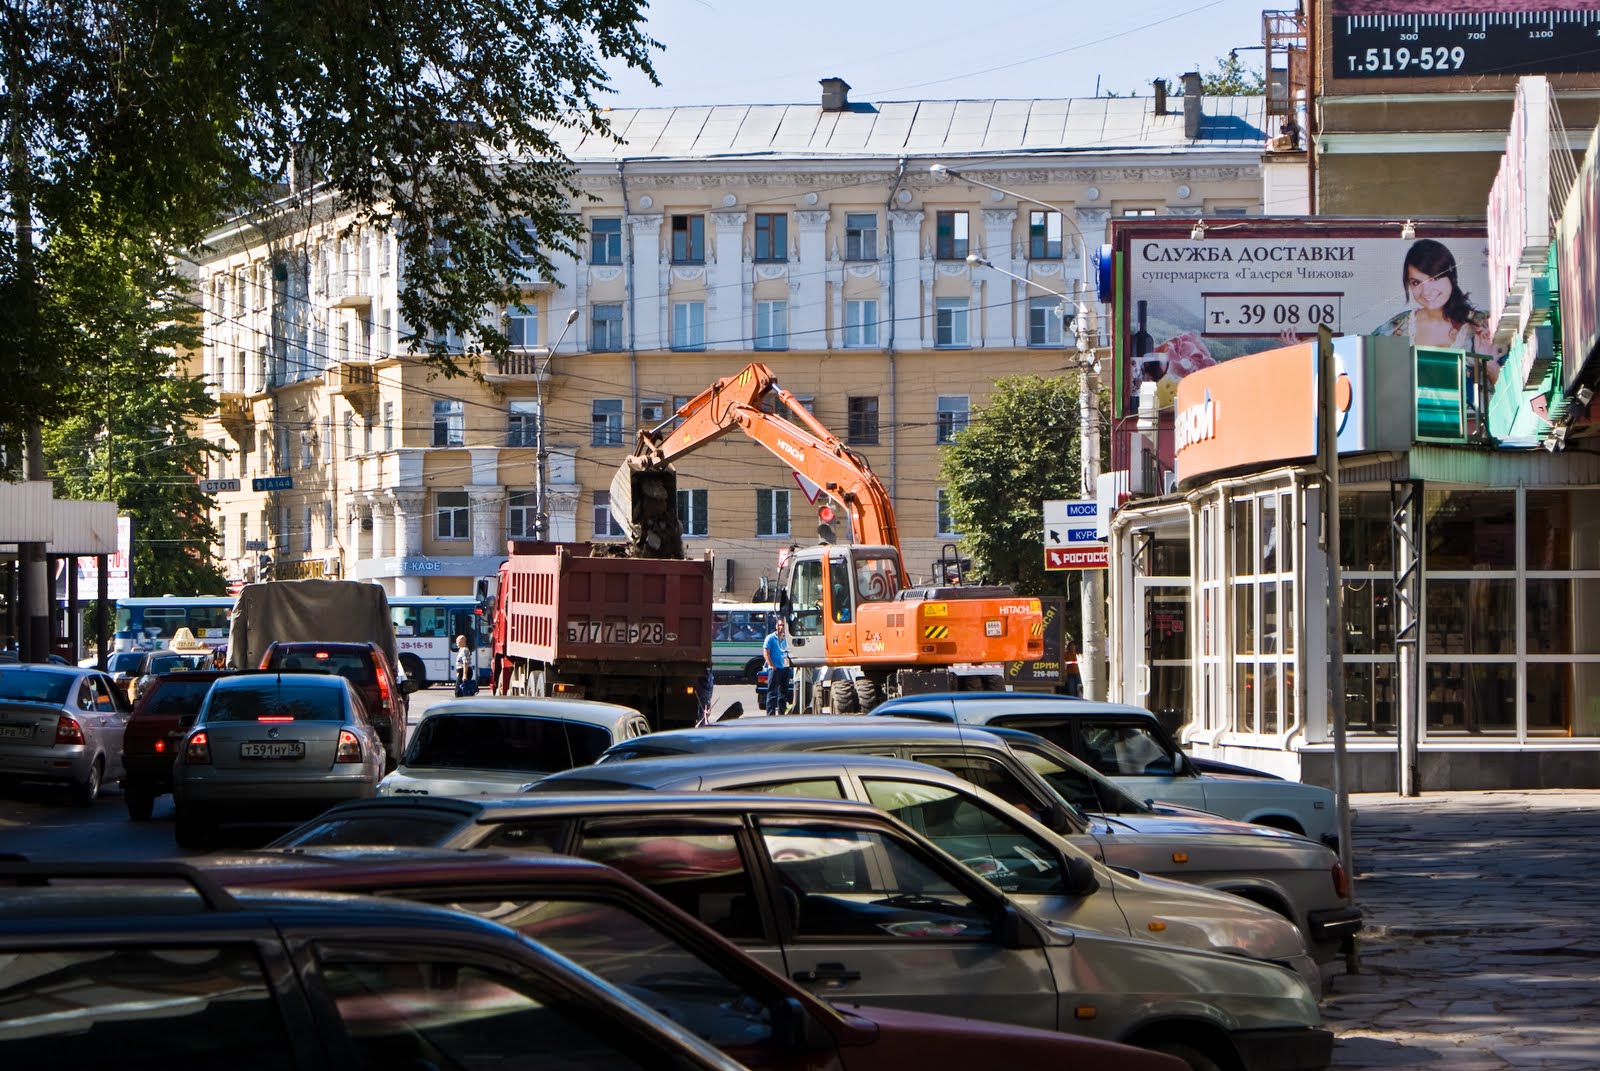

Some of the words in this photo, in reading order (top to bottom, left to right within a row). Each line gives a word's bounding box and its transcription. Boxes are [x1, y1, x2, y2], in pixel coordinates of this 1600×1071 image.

[1467, 32, 1486, 40] 700
[1529, 30, 1554, 38] 1100
[1142, 243, 1233, 262] СЛУЖБА
[1142, 269, 1229, 283] супермаркета
[1235, 267, 1292, 282] «Галерея
[1297, 267, 1354, 280] Чижова»
[1210, 310, 1231, 325] т.
[1238, 304, 1266, 325] 39
[1273, 303, 1300, 325] 08
[1307, 303, 1335, 324] 08
[777, 438, 805, 462] HITACHI
[206, 481, 235, 490] СТОП
[1070, 505, 1097, 515] МОСК
[999, 605, 1030, 615] HITACHI
[400, 642, 433, 650] 39-16-16
[862, 642, 885, 653] 160W
[1033, 662, 1059, 670] ДРИМ
